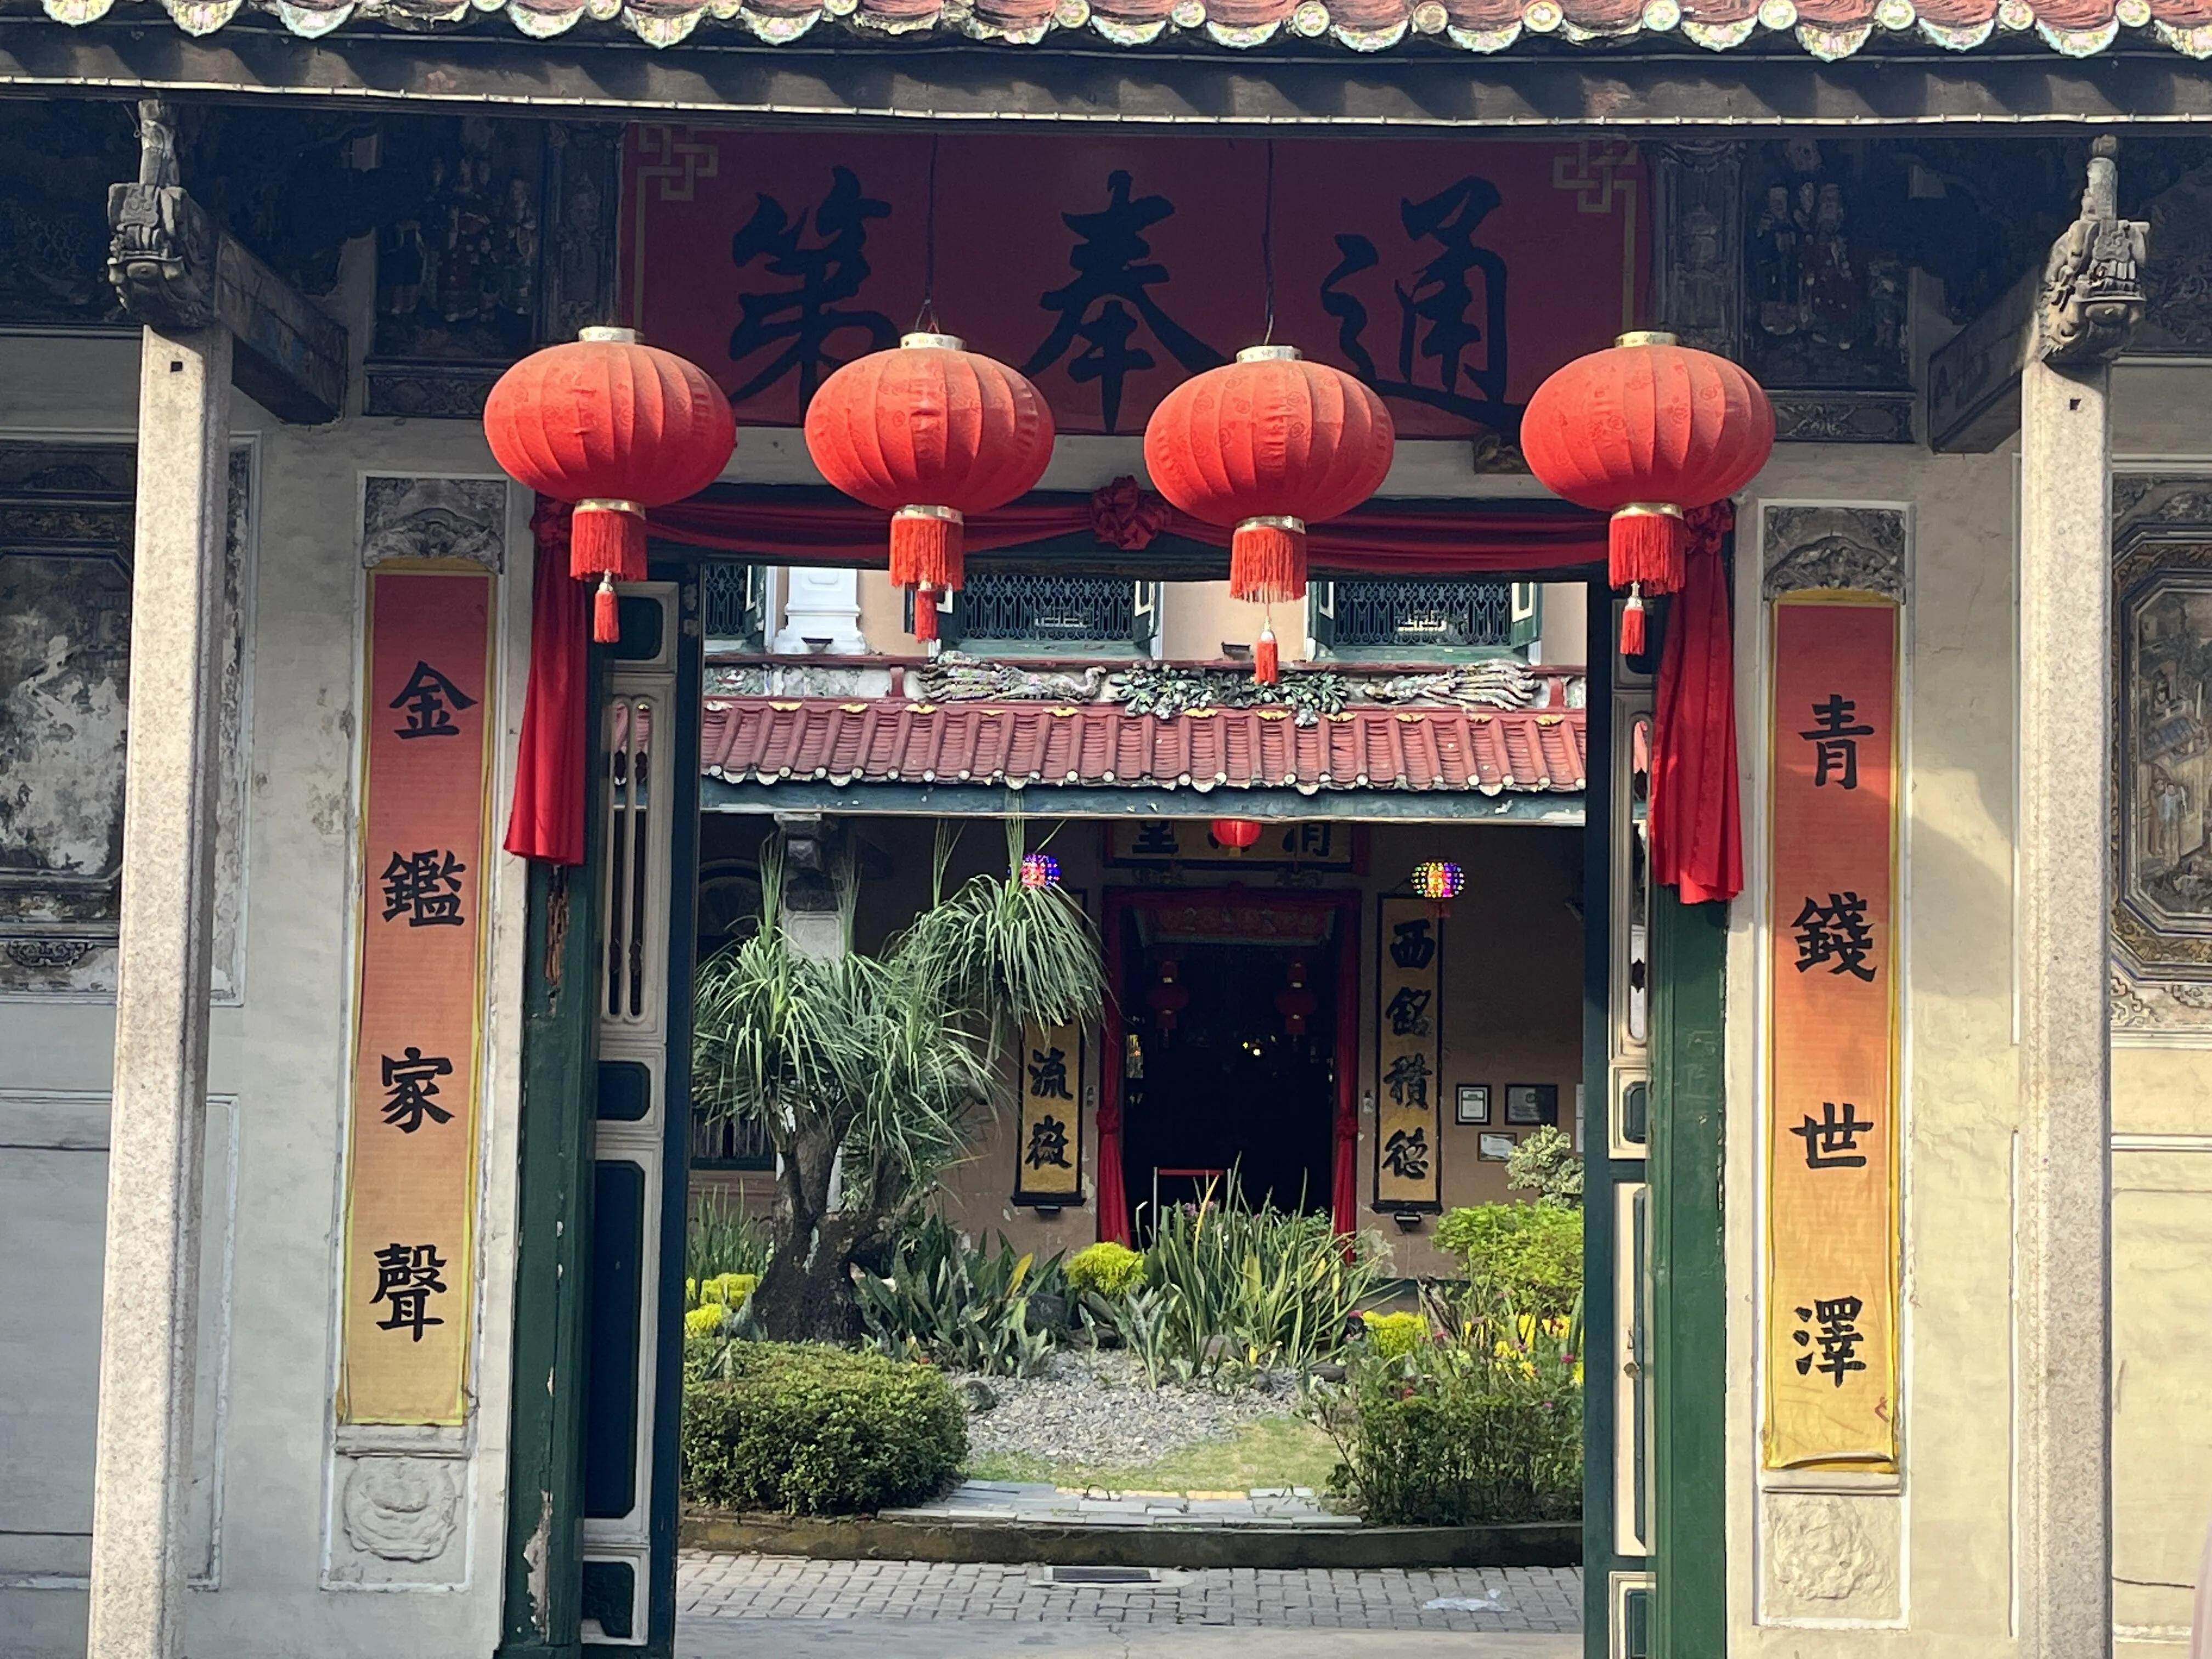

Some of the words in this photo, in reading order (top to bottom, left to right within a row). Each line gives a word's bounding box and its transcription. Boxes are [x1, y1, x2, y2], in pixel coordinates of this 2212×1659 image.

[370, 661, 478, 1342] 金鑑家聲
[1789, 695, 1876, 1388] 青錢世澤
